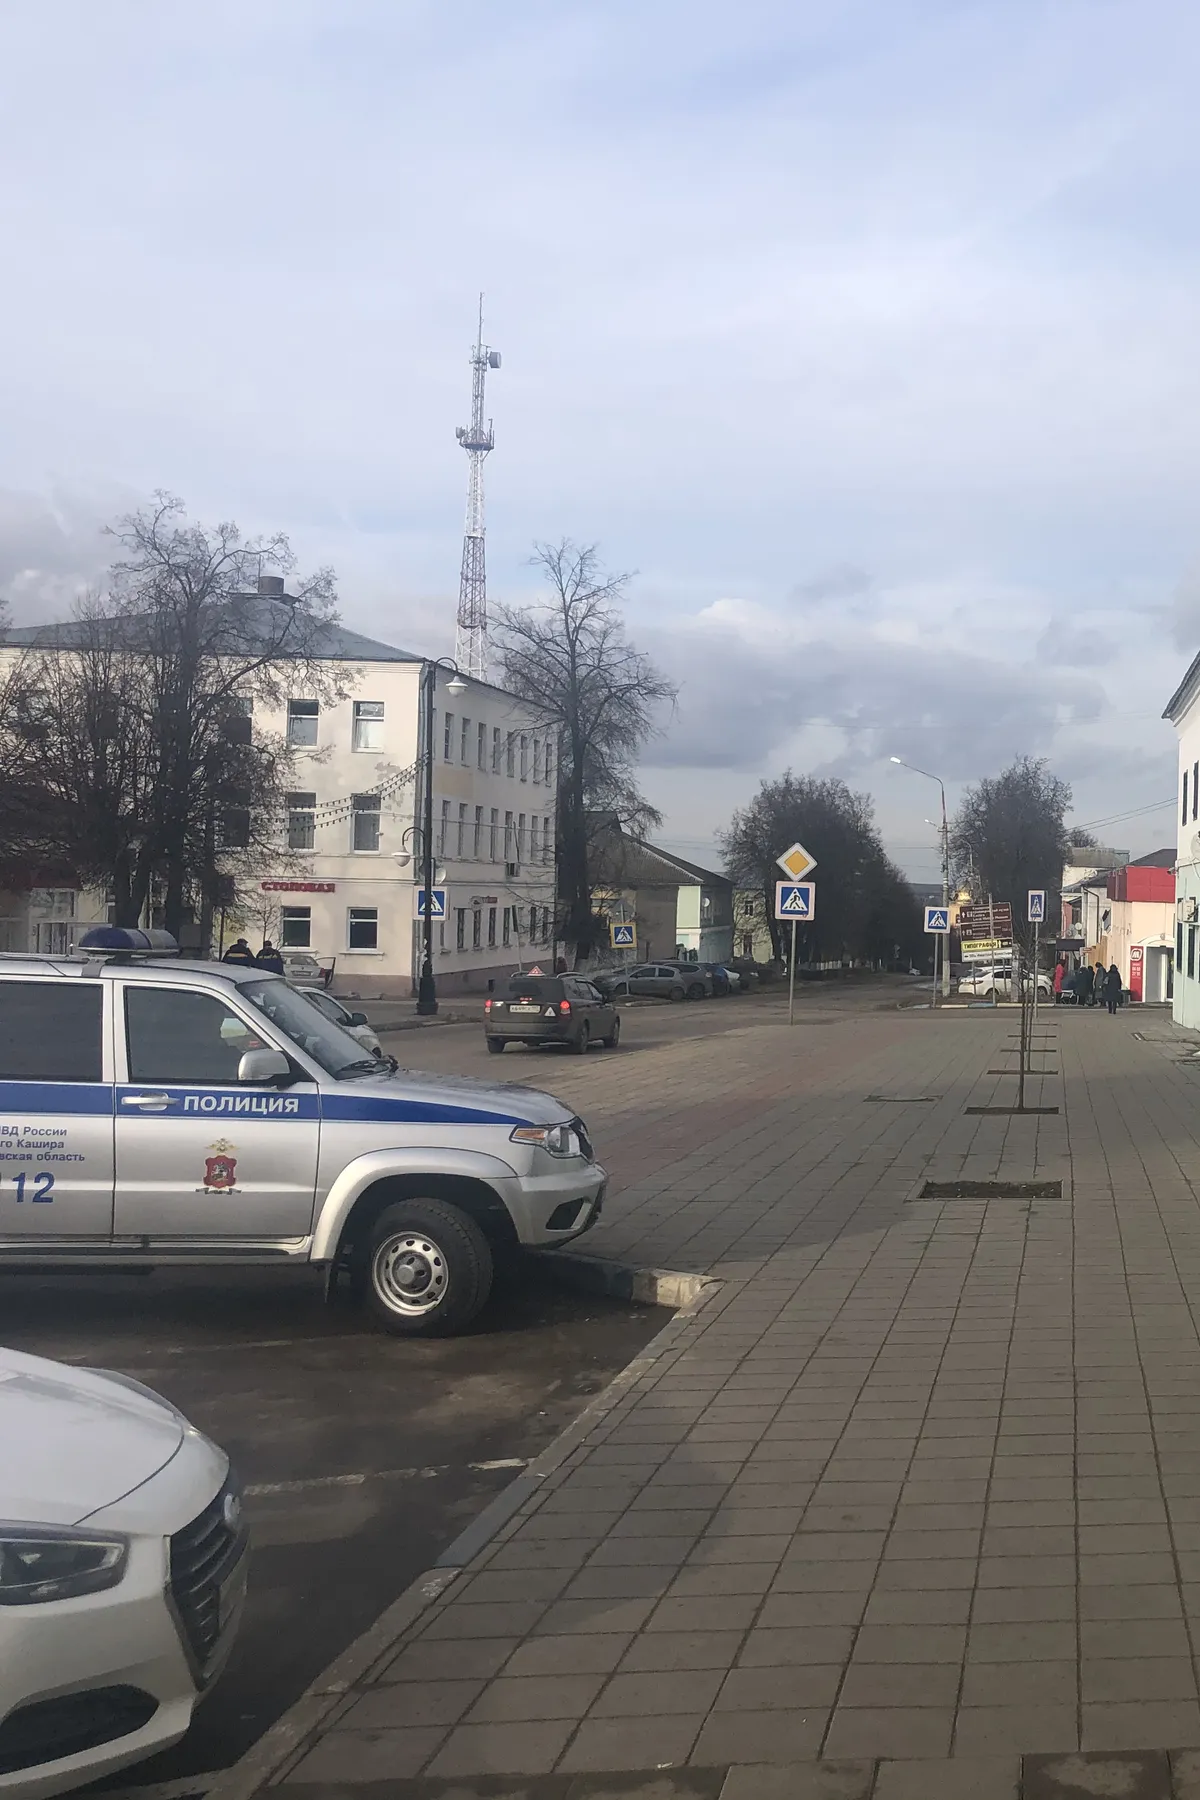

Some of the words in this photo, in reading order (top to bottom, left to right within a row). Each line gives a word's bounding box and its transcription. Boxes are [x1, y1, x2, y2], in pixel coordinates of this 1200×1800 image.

[183, 1095, 299, 1114] ПОЛИЦИЯ
[0, 1126, 19, 1137] ВД
[23, 1126, 68, 1136] России
[17, 1139, 65, 1150] Кашира
[36, 1152, 85, 1161] область
[0, 1172, 55, 1203] 12
